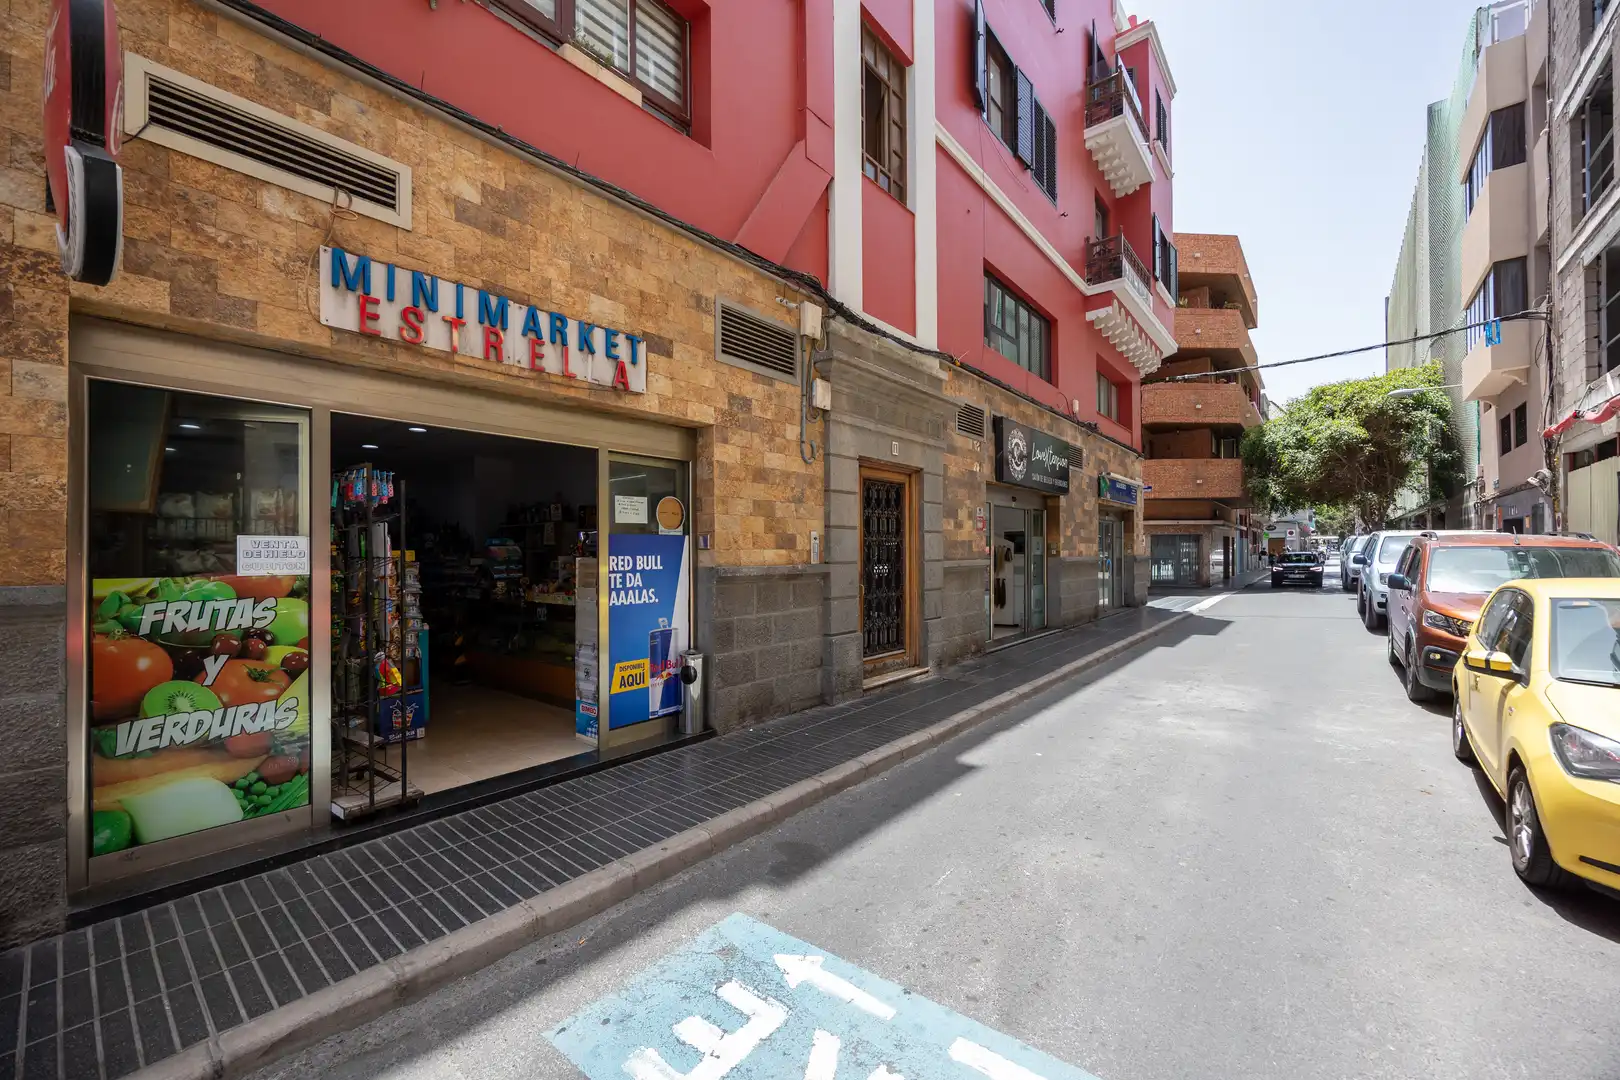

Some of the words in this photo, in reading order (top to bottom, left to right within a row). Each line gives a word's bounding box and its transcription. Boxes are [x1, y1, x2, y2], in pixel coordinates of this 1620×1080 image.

[332, 247, 643, 365] MINIMARKET
[243, 549, 262, 559] DE
[263, 549, 306, 559] HIELO
[250, 539, 299, 550] VENTA
[609, 555, 633, 571] RED
[636, 554, 663, 570] BULL
[608, 573, 623, 589] TE
[626, 572, 643, 588] DA
[609, 588, 659, 606] AAALAS.
[138, 597, 278, 636] FRUTAS
[202, 654, 230, 686] Y
[619, 668, 645, 689] AQUÍ
[114, 697, 300, 757] VERDURAS
